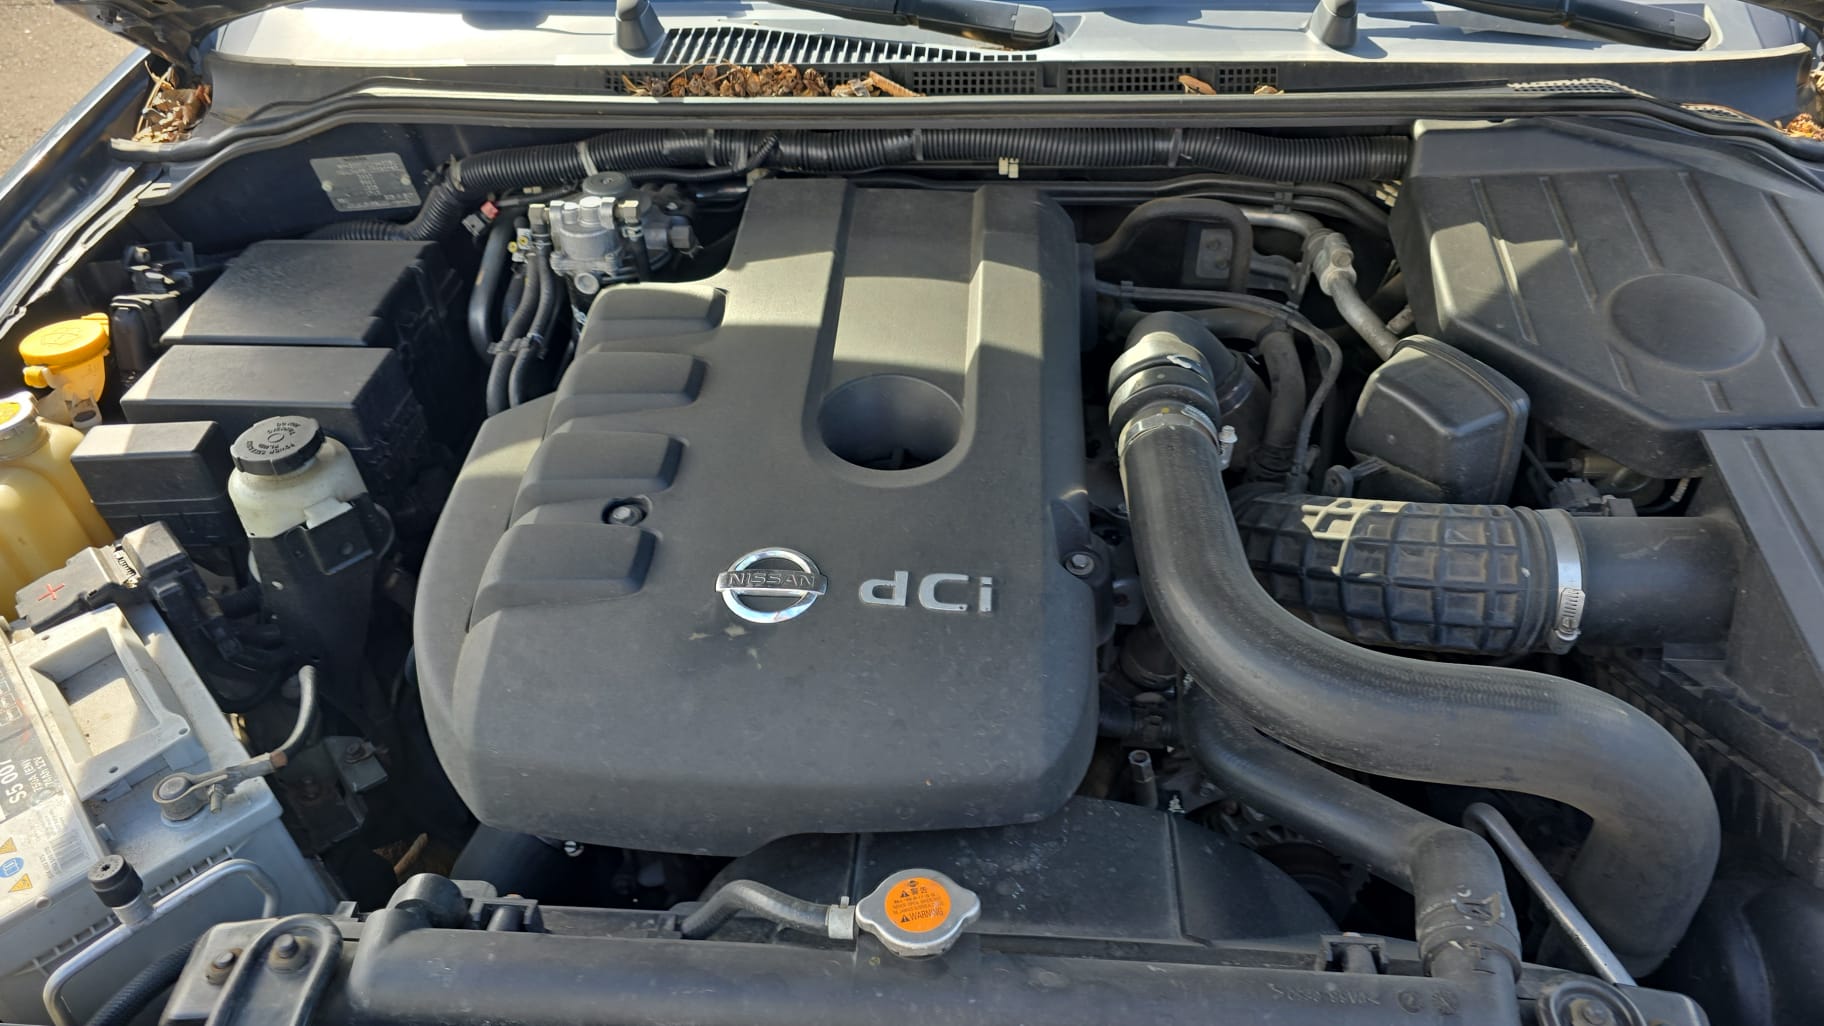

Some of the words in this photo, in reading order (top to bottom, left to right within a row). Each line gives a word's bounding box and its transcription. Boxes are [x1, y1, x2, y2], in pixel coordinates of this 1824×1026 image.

[728, 572, 815, 587] NISSAN
[858, 570, 993, 613] dCi
[5, 783, 27, 804] S5
[909, 908, 944, 921] WARNING
